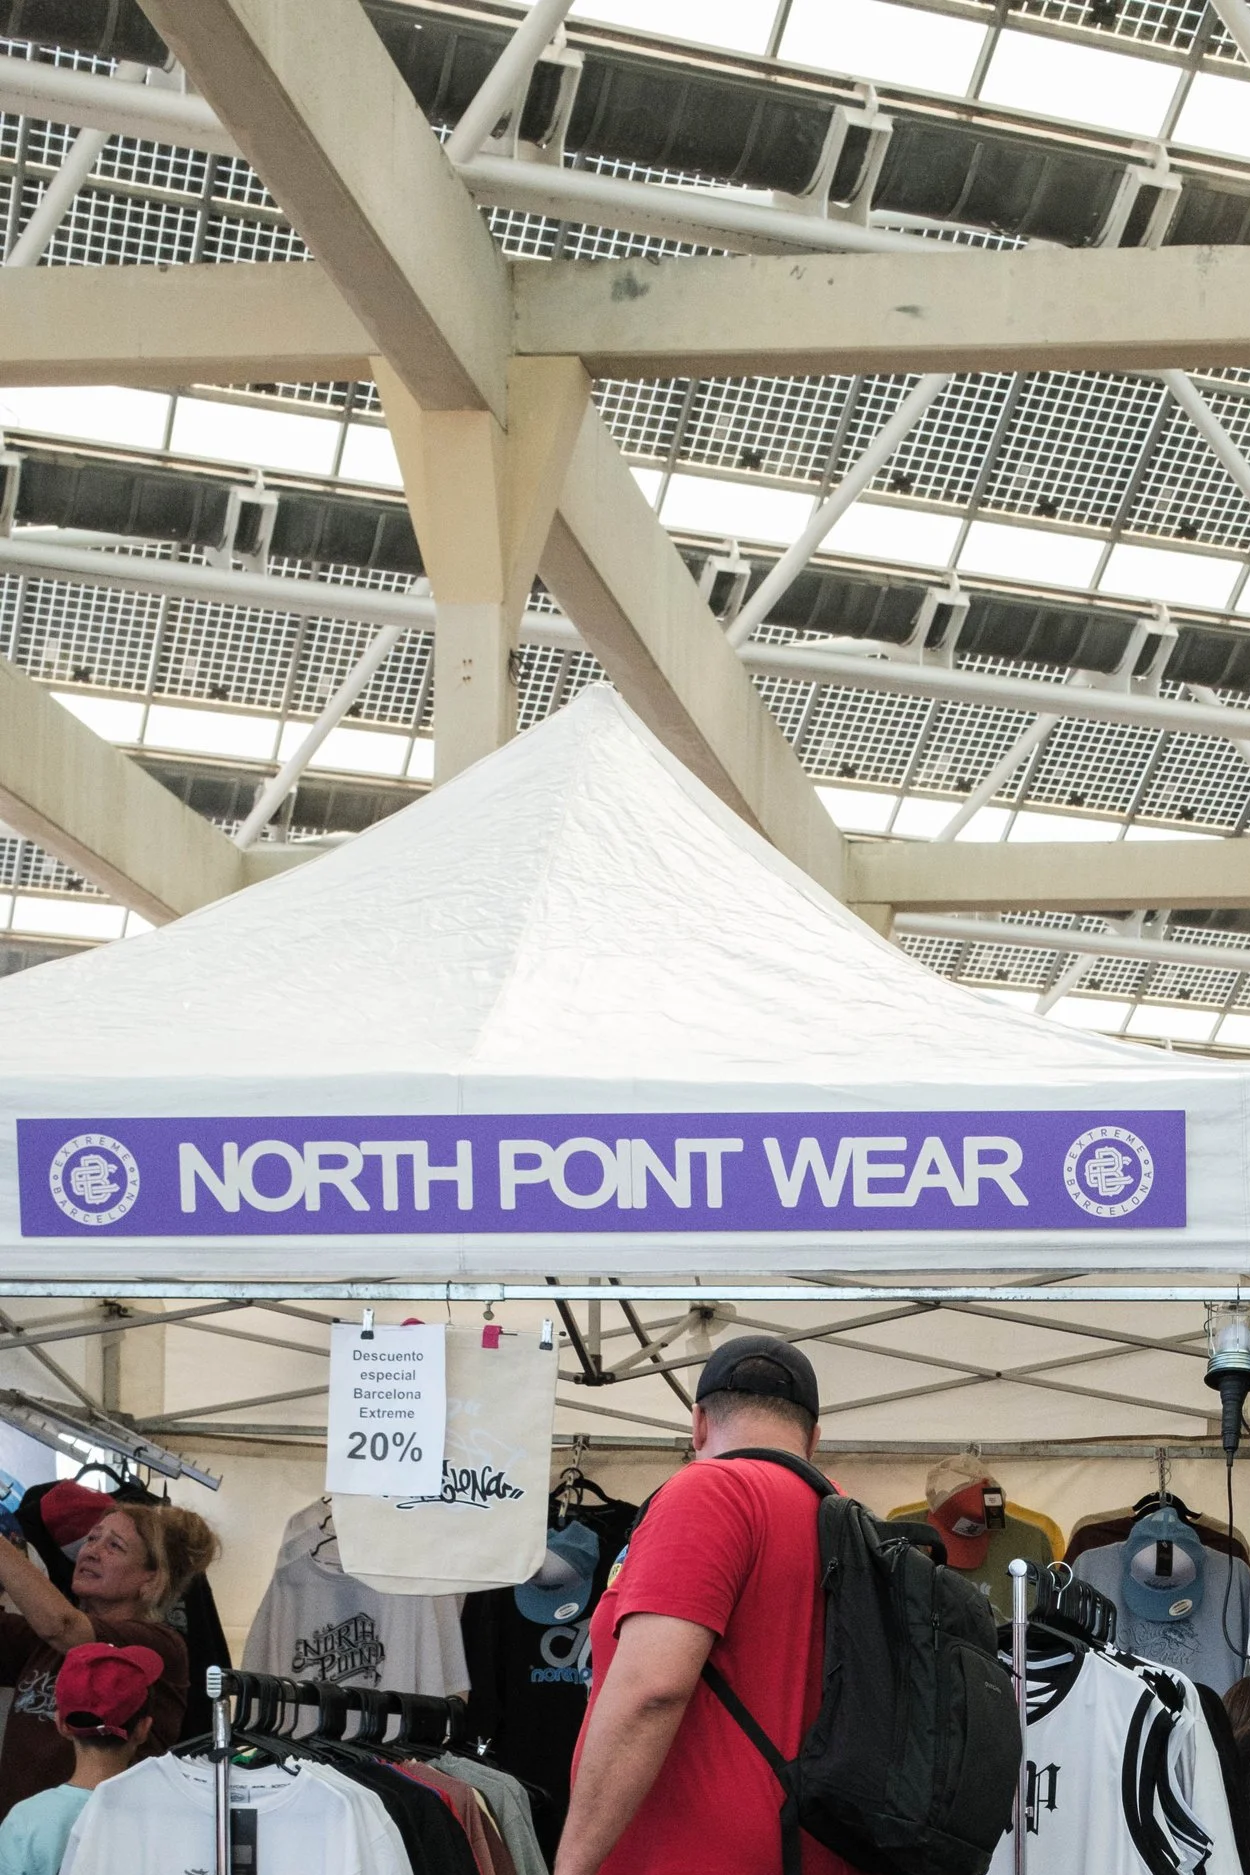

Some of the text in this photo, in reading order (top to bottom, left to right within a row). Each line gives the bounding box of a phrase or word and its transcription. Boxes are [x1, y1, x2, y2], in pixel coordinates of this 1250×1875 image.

[179, 1140, 472, 1213] NORTH
[501, 1137, 743, 1209] POINT
[763, 1136, 1028, 1207] WEAR
[352, 1349, 424, 1362] Descuento
[360, 1369, 416, 1382] especial
[353, 1387, 422, 1400] Barcelona
[359, 1406, 415, 1419] Extreme
[347, 1431, 423, 1462] 20%
